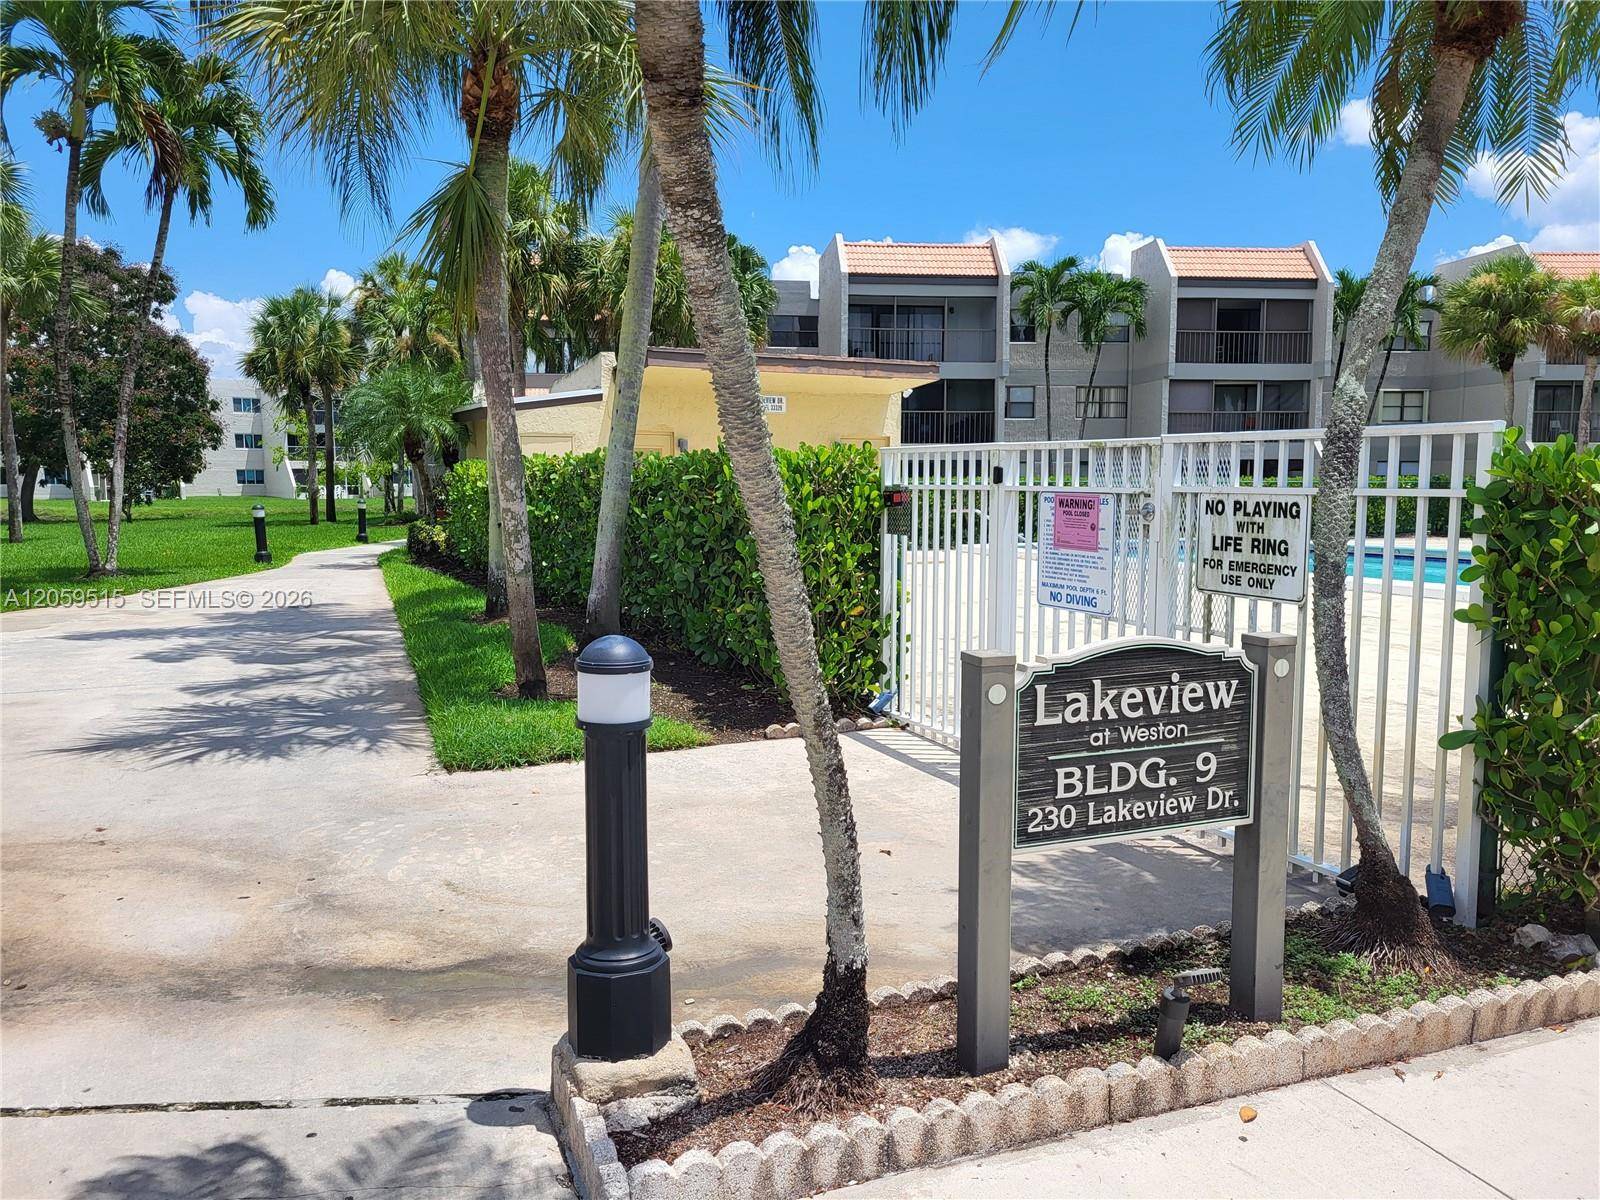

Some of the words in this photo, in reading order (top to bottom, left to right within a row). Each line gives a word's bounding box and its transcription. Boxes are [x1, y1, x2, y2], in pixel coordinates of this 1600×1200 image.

[1058, 498, 1095, 510] WARNING!
[1205, 499, 1225, 516] NO
[1233, 500, 1301, 520] PLAYING
[1236, 521, 1264, 534] WITH
[1212, 535, 1243, 553] LIFE
[1251, 538, 1289, 557] RING
[1203, 558, 1223, 570] FOR
[1228, 560, 1297, 577] EMERGENCY
[1041, 581, 1065, 589] MAXIMUM
[1066, 584, 1078, 592] POOL
[1079, 586, 1094, 594] DEPTH
[1221, 574, 1242, 586] USE
[1247, 577, 1275, 590] ONLY
[1049, 591, 1062, 602] NO
[1066, 593, 1097, 608] DIVING
[1034, 672, 1239, 726] Lakeview
[1089, 731, 1110, 747] at
[1120, 723, 1188, 743] Weston
[1055, 757, 1177, 800] BLDG.
[1195, 752, 1217, 783] 9
[1027, 804, 1076, 833] 230
[1087, 793, 1197, 826] Lakeview
[1206, 787, 1239, 810] Dr.
